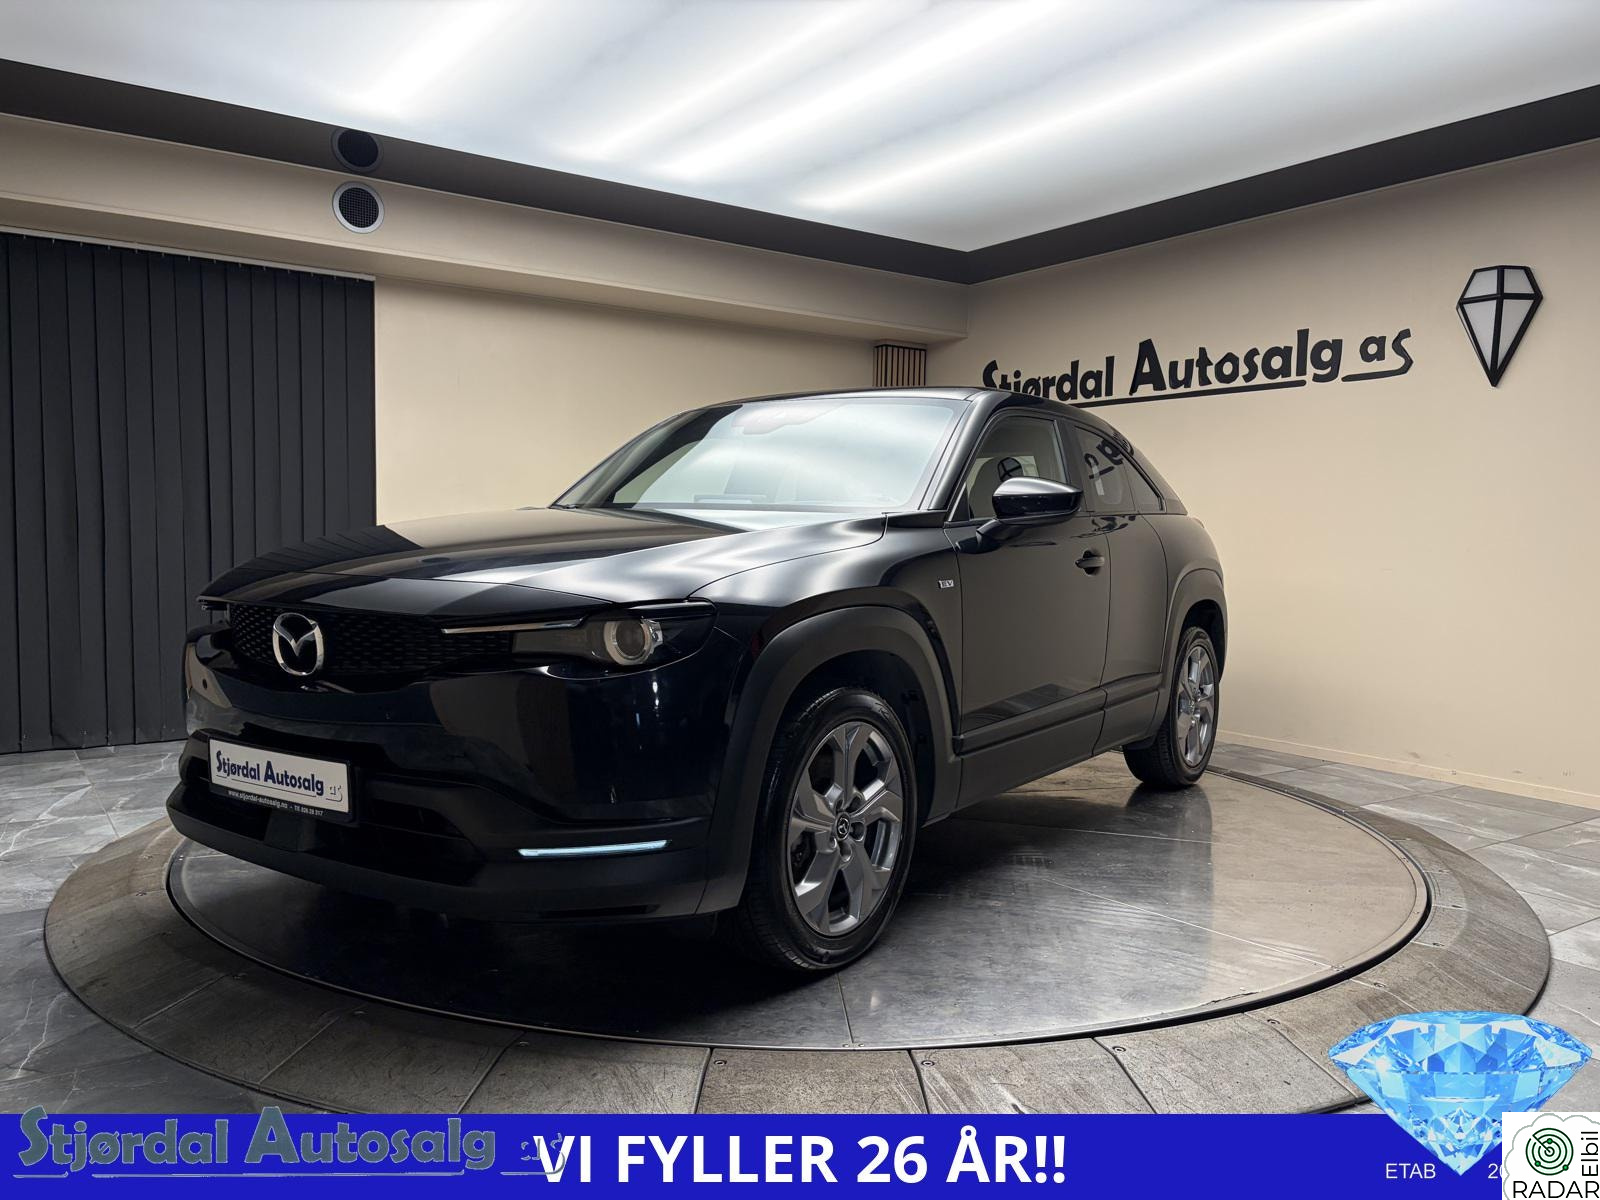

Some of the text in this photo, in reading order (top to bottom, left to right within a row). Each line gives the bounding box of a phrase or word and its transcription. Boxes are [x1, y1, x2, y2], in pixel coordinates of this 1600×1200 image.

[1129, 329, 1343, 395] Autosalg
[216, 750, 261, 781] Stjørdal
[264, 760, 324, 796] Autosalg
